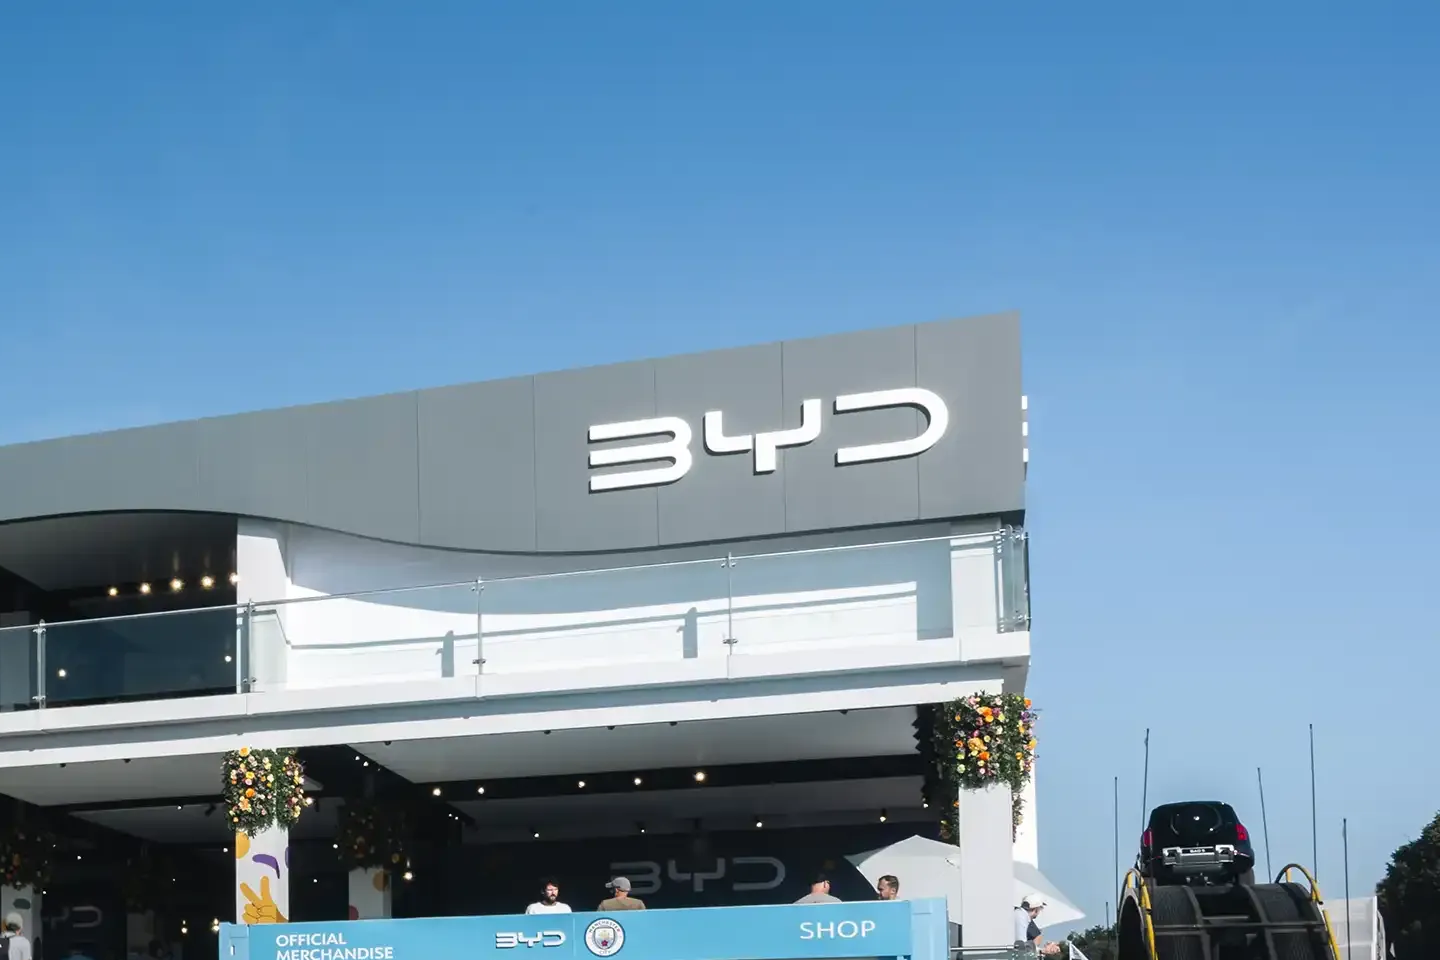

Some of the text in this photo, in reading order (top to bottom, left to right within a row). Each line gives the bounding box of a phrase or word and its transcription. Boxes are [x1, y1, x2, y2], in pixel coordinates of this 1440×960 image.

[588, 387, 949, 493] BYD
[610, 857, 786, 895] BYD
[41, 905, 102, 931] YD
[275, 932, 347, 947] OFFICIAL
[495, 930, 566, 948] BYD
[800, 920, 876, 939] SHOP
